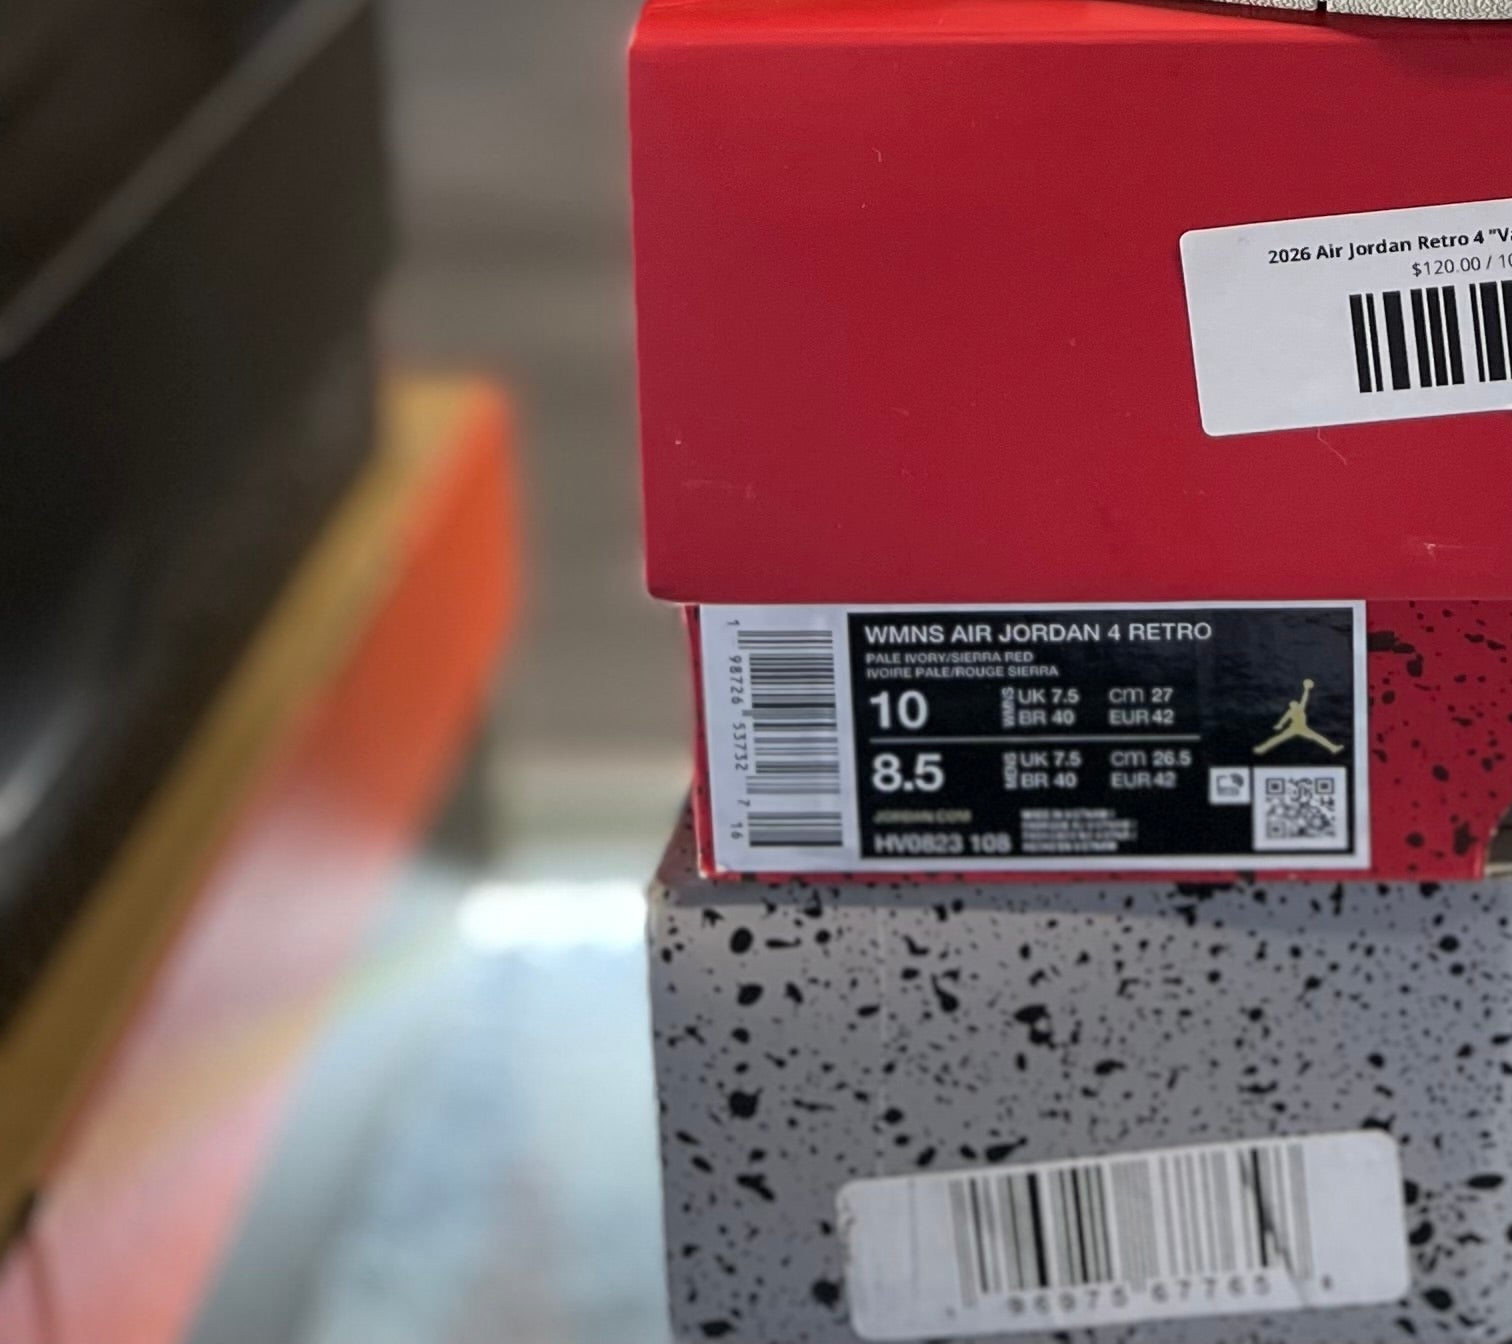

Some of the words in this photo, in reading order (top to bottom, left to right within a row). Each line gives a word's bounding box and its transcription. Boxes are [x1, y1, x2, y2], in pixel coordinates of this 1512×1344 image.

[1268, 247, 1312, 264] 2026
[1316, 244, 1343, 260] Air
[1348, 238, 1412, 260] Jordan
[1418, 233, 1469, 250] Retro
[1473, 229, 1485, 244] 4
[1411, 255, 1481, 278] $120.00
[865, 625, 945, 643] WMNS
[951, 625, 991, 642] AIR
[999, 623, 1100, 642] JORDAN
[1107, 624, 1121, 641] 4
[1129, 622, 1212, 641] RETRO
[866, 653, 900, 663] PALE
[905, 651, 1001, 663] IVORY/SIERRA
[1005, 651, 1033, 662] RED
[867, 667, 912, 678] IVOIRE
[916, 666, 1003, 677] PALE/ROUGE
[1008, 665, 1059, 676] SIERRA
[729, 655, 744, 705] 98726
[1018, 689, 1046, 703] UK
[1052, 688, 1079, 703] 7.5
[1109, 689, 1144, 703] cm
[1151, 688, 1173, 703] 27
[870, 690, 928, 729] 10
[1018, 710, 1047, 725] BR
[1051, 710, 1074, 725] 40
[1110, 710, 1149, 725] EUR
[1152, 710, 1174, 724] 42
[732, 722, 748, 771] 53732
[1021, 752, 1048, 766] UK
[1054, 751, 1081, 766] 7.5
[1110, 752, 1147, 766] cm
[1152, 750, 1191, 765] 26.5
[873, 752, 944, 792] 8.5
[1021, 773, 1049, 788] BR
[1053, 772, 1077, 788] 40
[1111, 772, 1150, 787] EUR
[1154, 772, 1177, 787] 42
